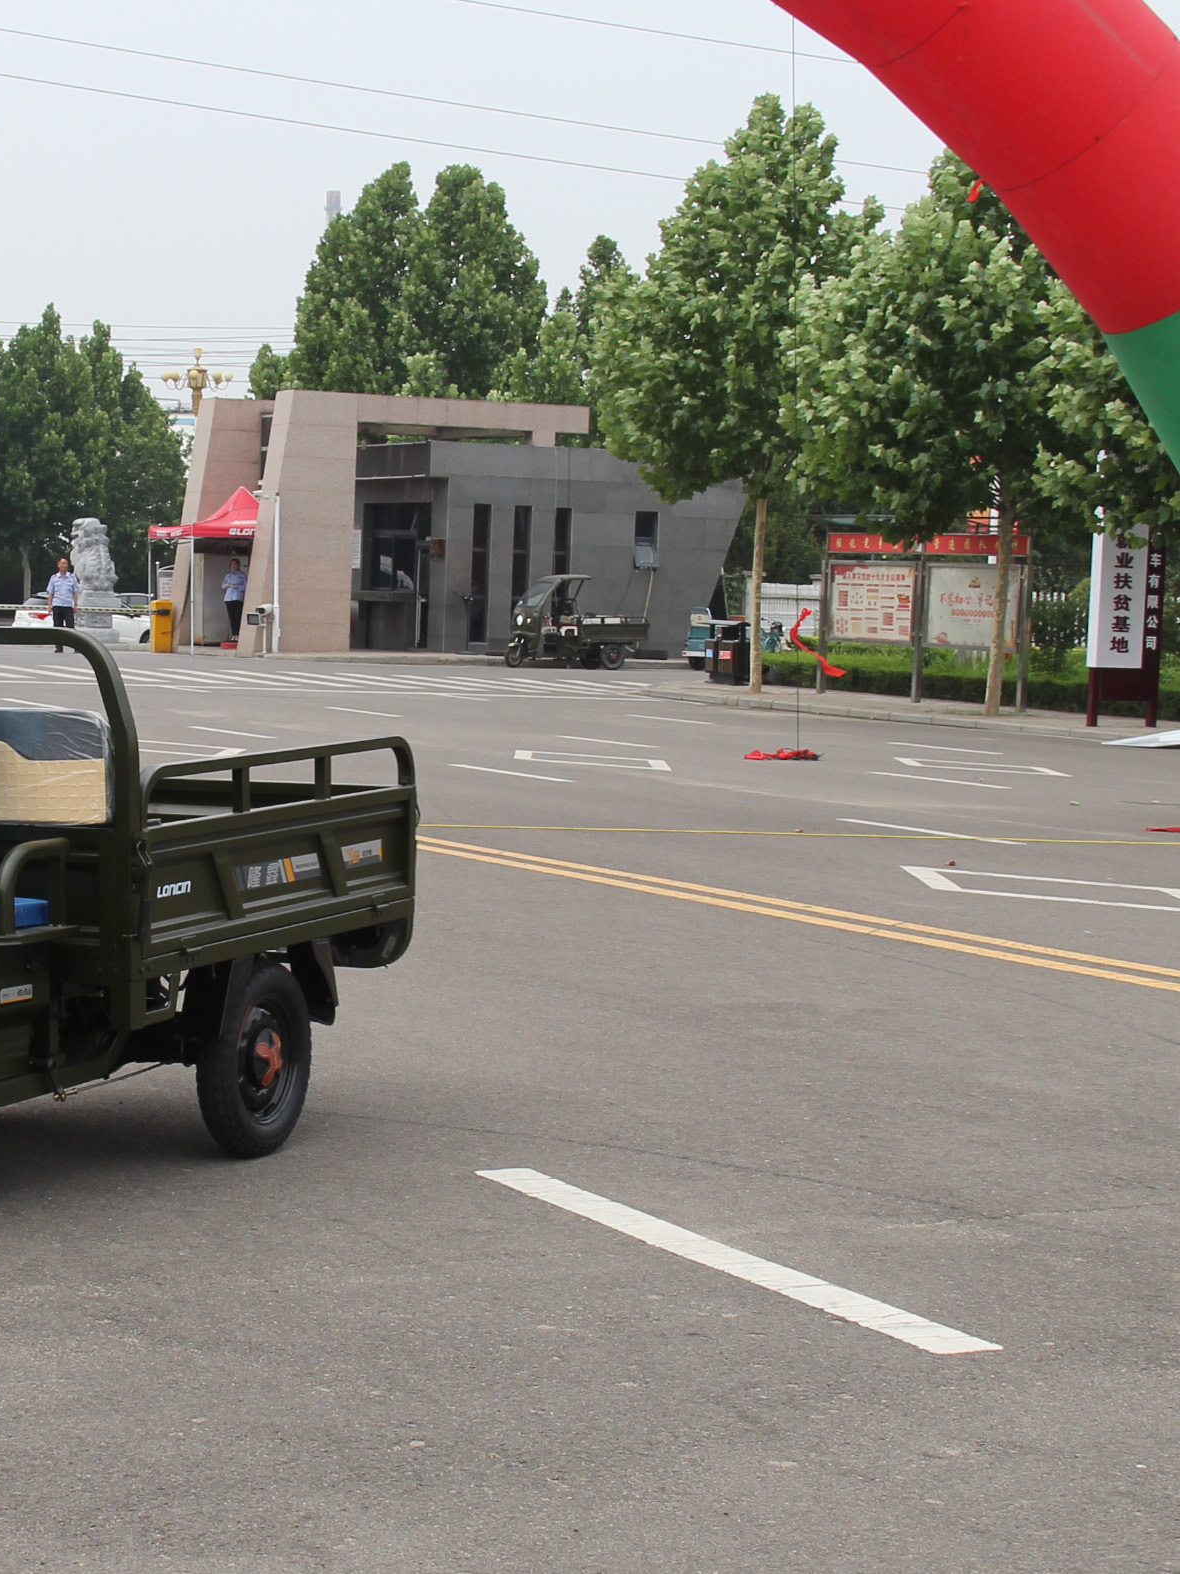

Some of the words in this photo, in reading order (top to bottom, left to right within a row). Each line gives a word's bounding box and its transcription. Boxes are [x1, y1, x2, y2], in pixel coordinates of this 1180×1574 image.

[1145, 531, 1162, 650] 车有限公司
[156, 880, 191, 899] LONCIN
